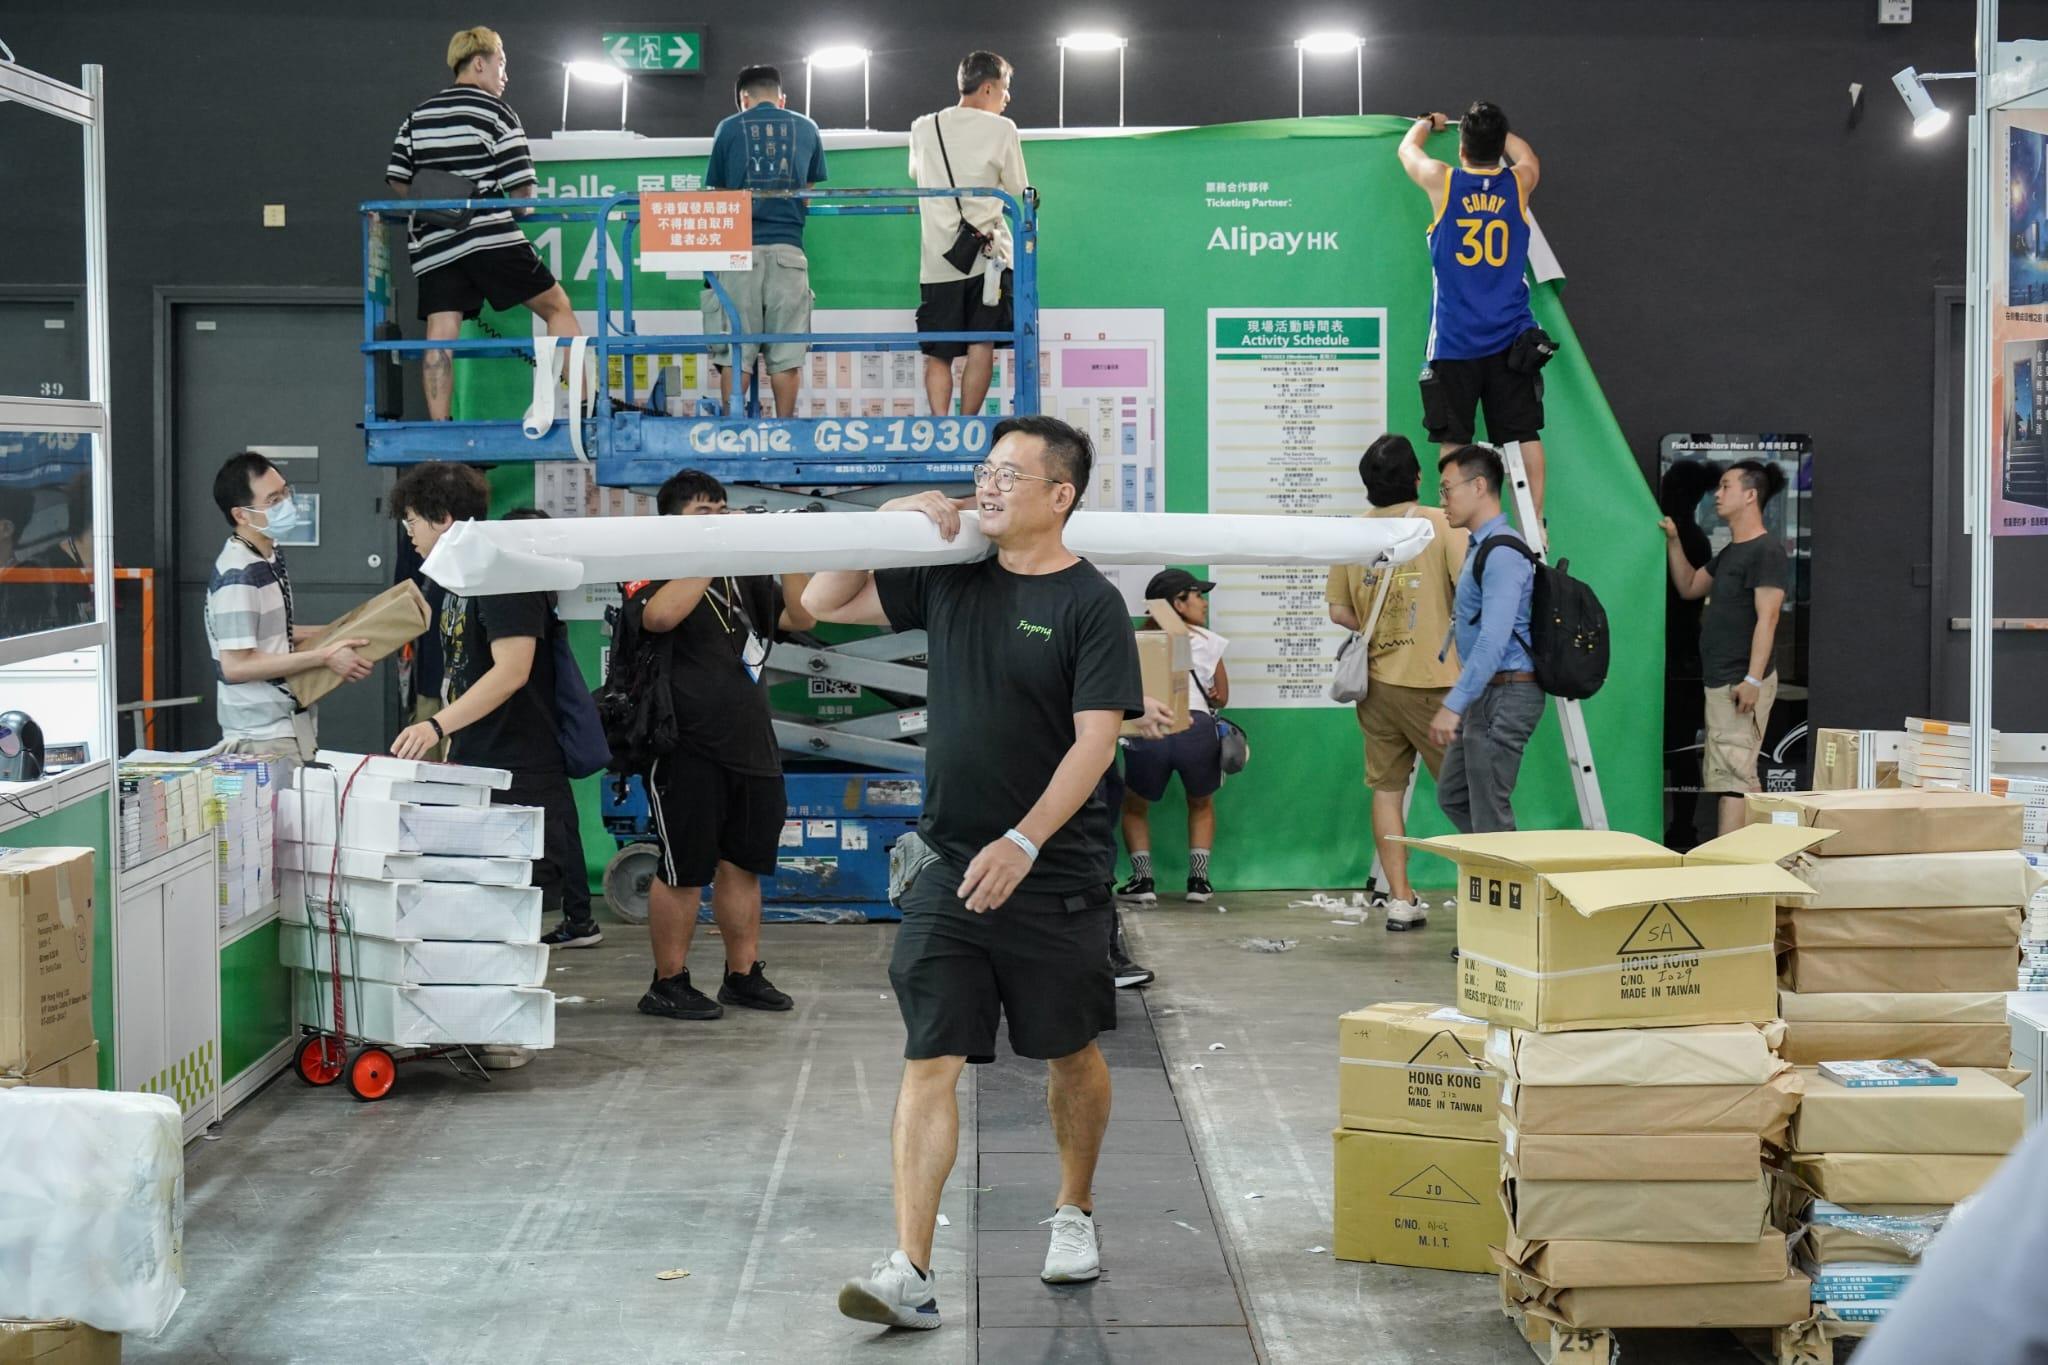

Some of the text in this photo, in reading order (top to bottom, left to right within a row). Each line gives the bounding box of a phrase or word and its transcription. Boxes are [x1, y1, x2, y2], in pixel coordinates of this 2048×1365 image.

[651, 202, 741, 215] 香港貿發局器材
[1206, 198, 1293, 209] Ticketing Partner:
[1462, 193, 1506, 214] CURRY
[657, 218, 734, 231] 不得擅自取用
[670, 234, 722, 246] 違者必究
[1206, 225, 1339, 256] Alipay HK
[1455, 218, 1509, 267] 30
[1247, 320, 1344, 333] 現場活動時間表
[1241, 334, 1349, 347] Activity Schedule
[40, 382, 64, 396] 39
[689, 420, 987, 452] Genie GS-1930
[867, 465, 887, 473] 2012
[1767, 780, 1795, 789] HKTDC
[1647, 923, 1674, 943] SA
[1621, 952, 1699, 971] HONG KONG
[1620, 974, 1645, 986] C/NO.
[1620, 983, 1701, 1000] MADE IN TAIWAN
[1408, 1071, 1481, 1089] HONG KONG
[1408, 1087, 1431, 1097] C/NO.
[1408, 1097, 1483, 1113] MADE IN TAIWAN
[1394, 1217, 1421, 1231] C/NO.
